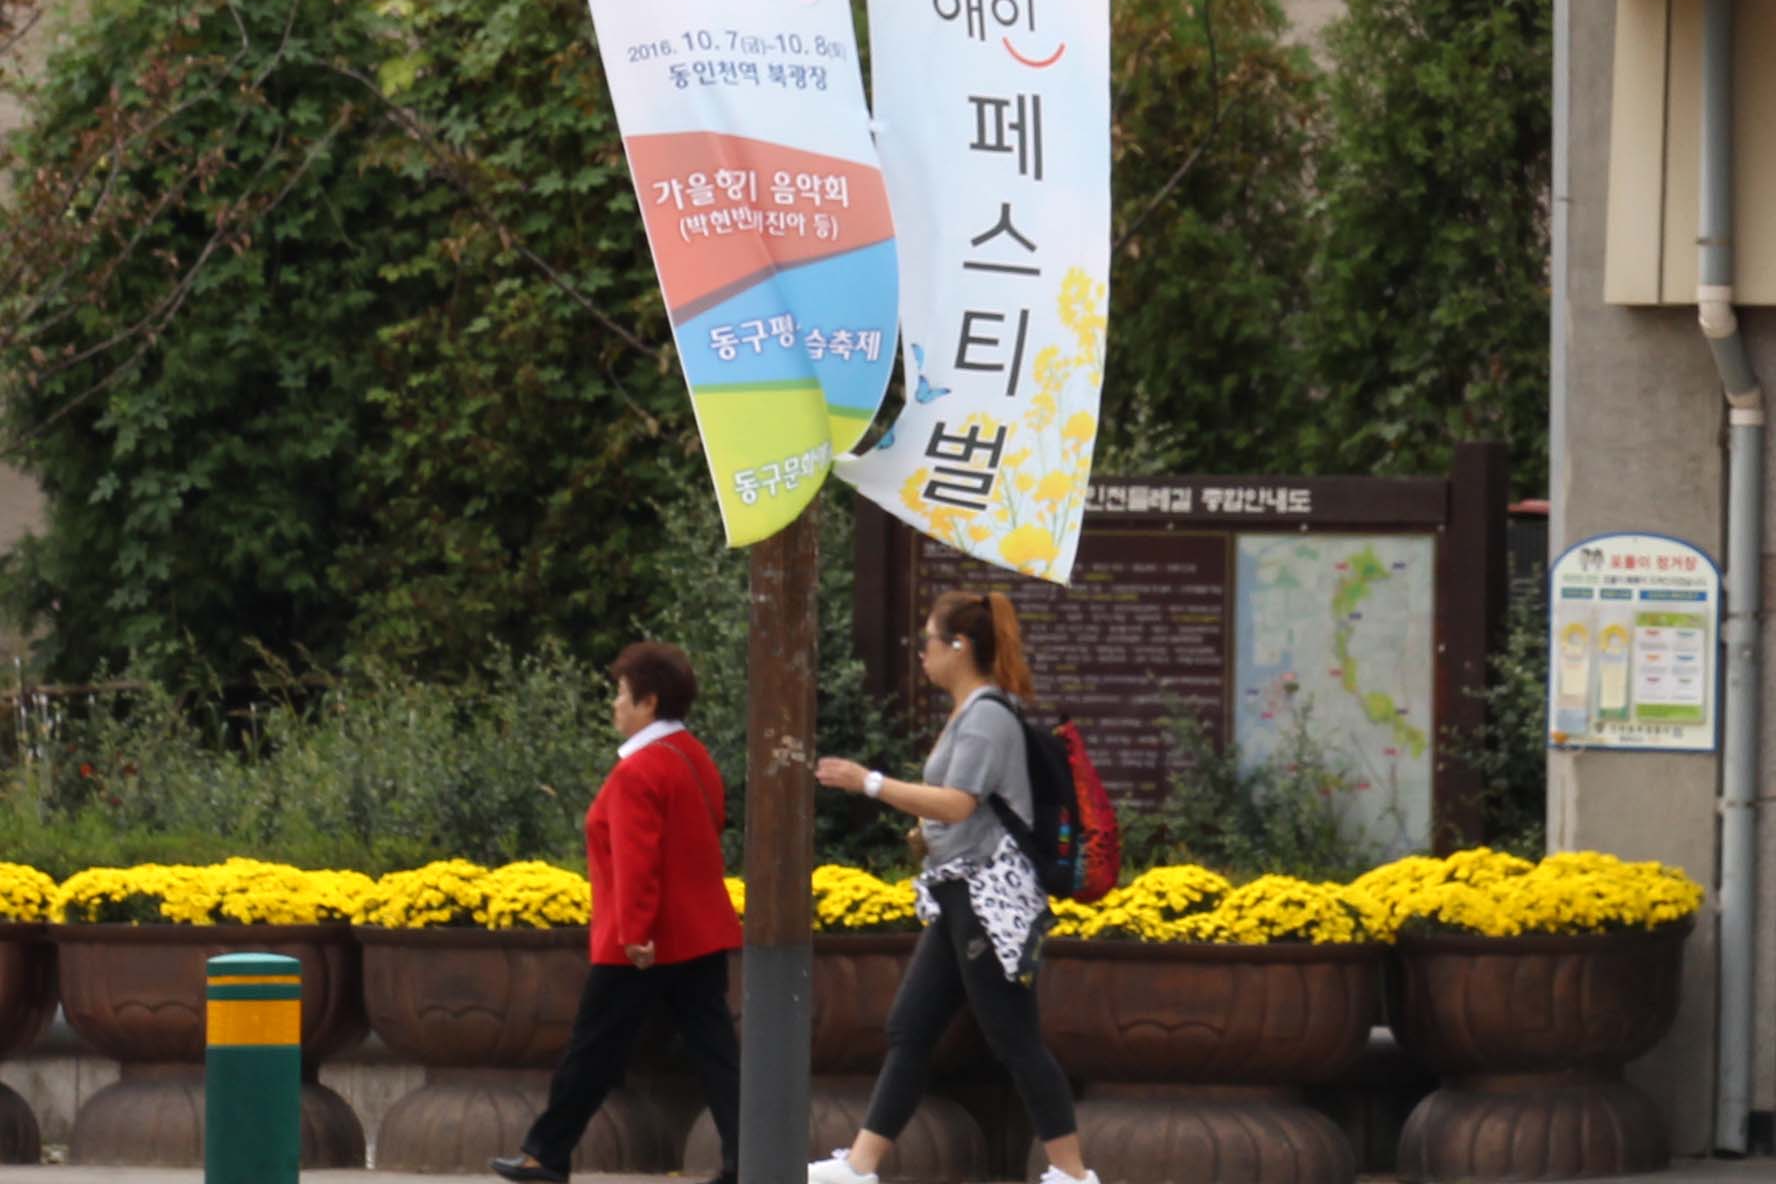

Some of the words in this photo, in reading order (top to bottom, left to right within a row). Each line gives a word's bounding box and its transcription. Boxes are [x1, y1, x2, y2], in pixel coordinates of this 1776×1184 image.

[669, 61, 760, 89] 동인천역
[768, 65, 827, 90] 북광장
[770, 171, 850, 208] 음악회
[921, 93, 1043, 511] 페스티벌
